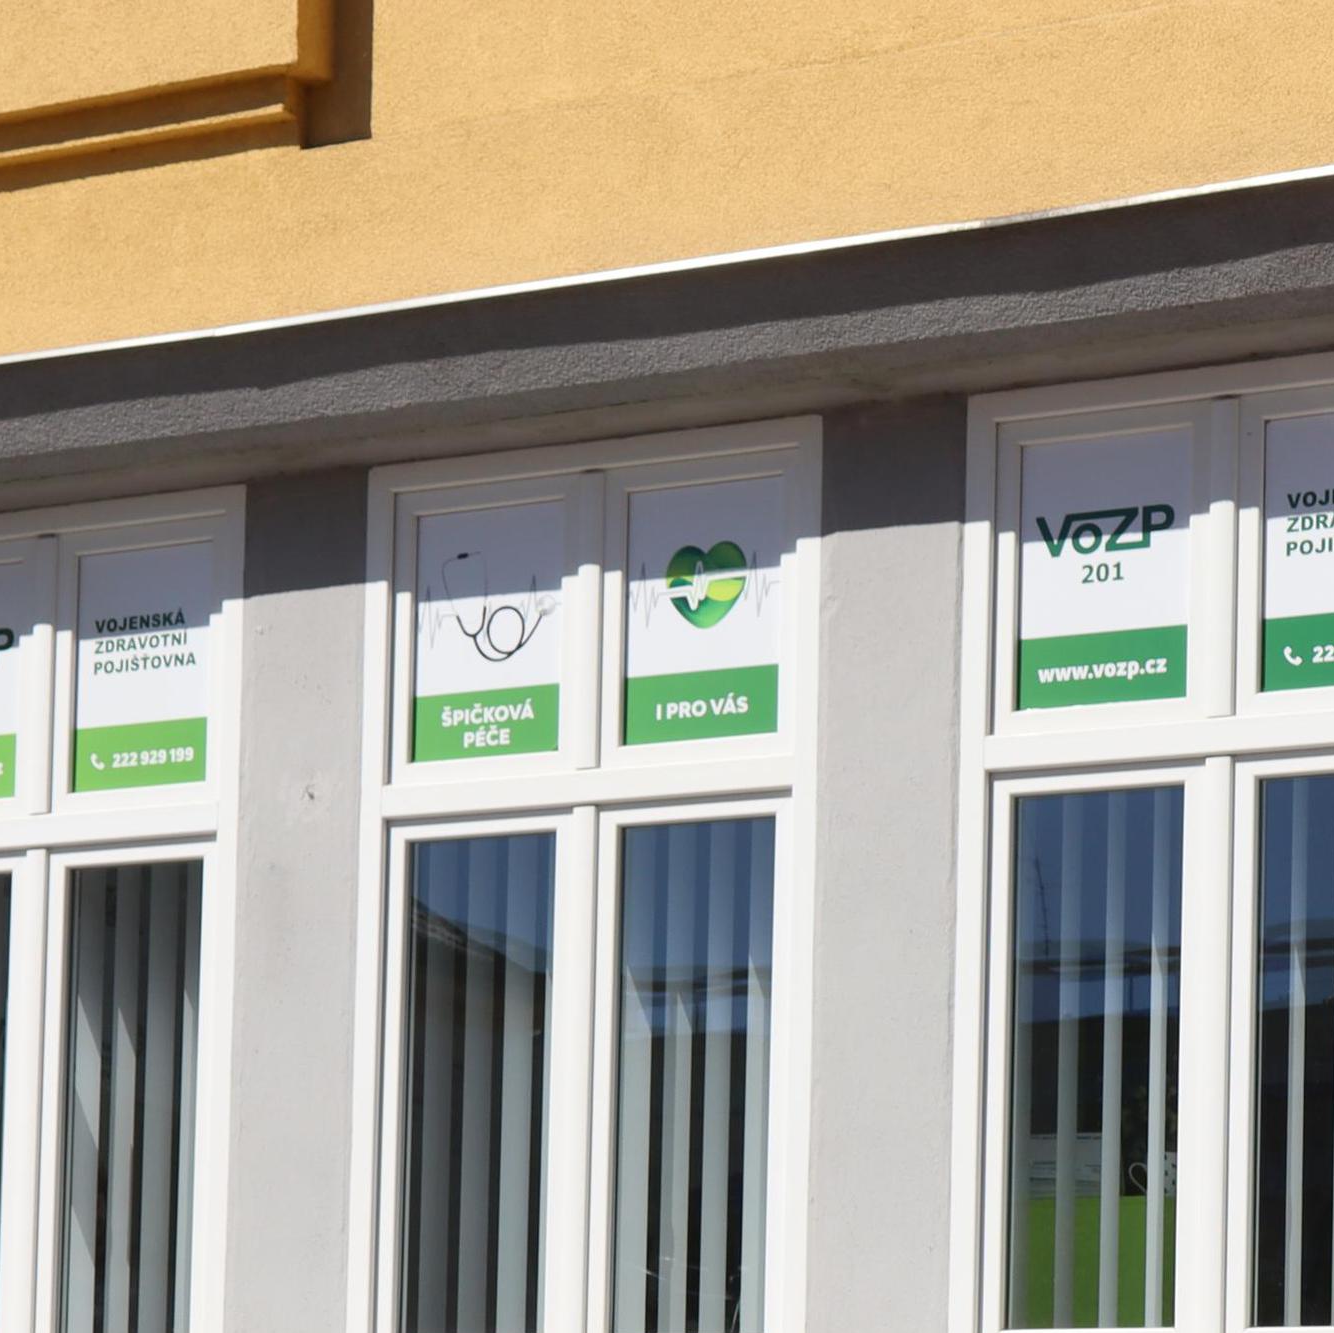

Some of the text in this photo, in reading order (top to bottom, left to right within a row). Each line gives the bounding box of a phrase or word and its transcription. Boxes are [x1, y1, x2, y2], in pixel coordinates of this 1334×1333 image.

[1081, 563, 1124, 584] 201
[95, 608, 186, 633] VOJENSKÁ
[94, 629, 188, 654] ZDRAVOTNÍ
[93, 651, 197, 675] POJIŠŤOVNA
[1038, 656, 1168, 684] www.vozp.cz
[441, 698, 535, 727] ŠPIČKOVÁ
[655, 694, 749, 721] I PRO VÁS
[463, 724, 510, 748] PÉČE
[112, 746, 194, 768] 222 929 199
